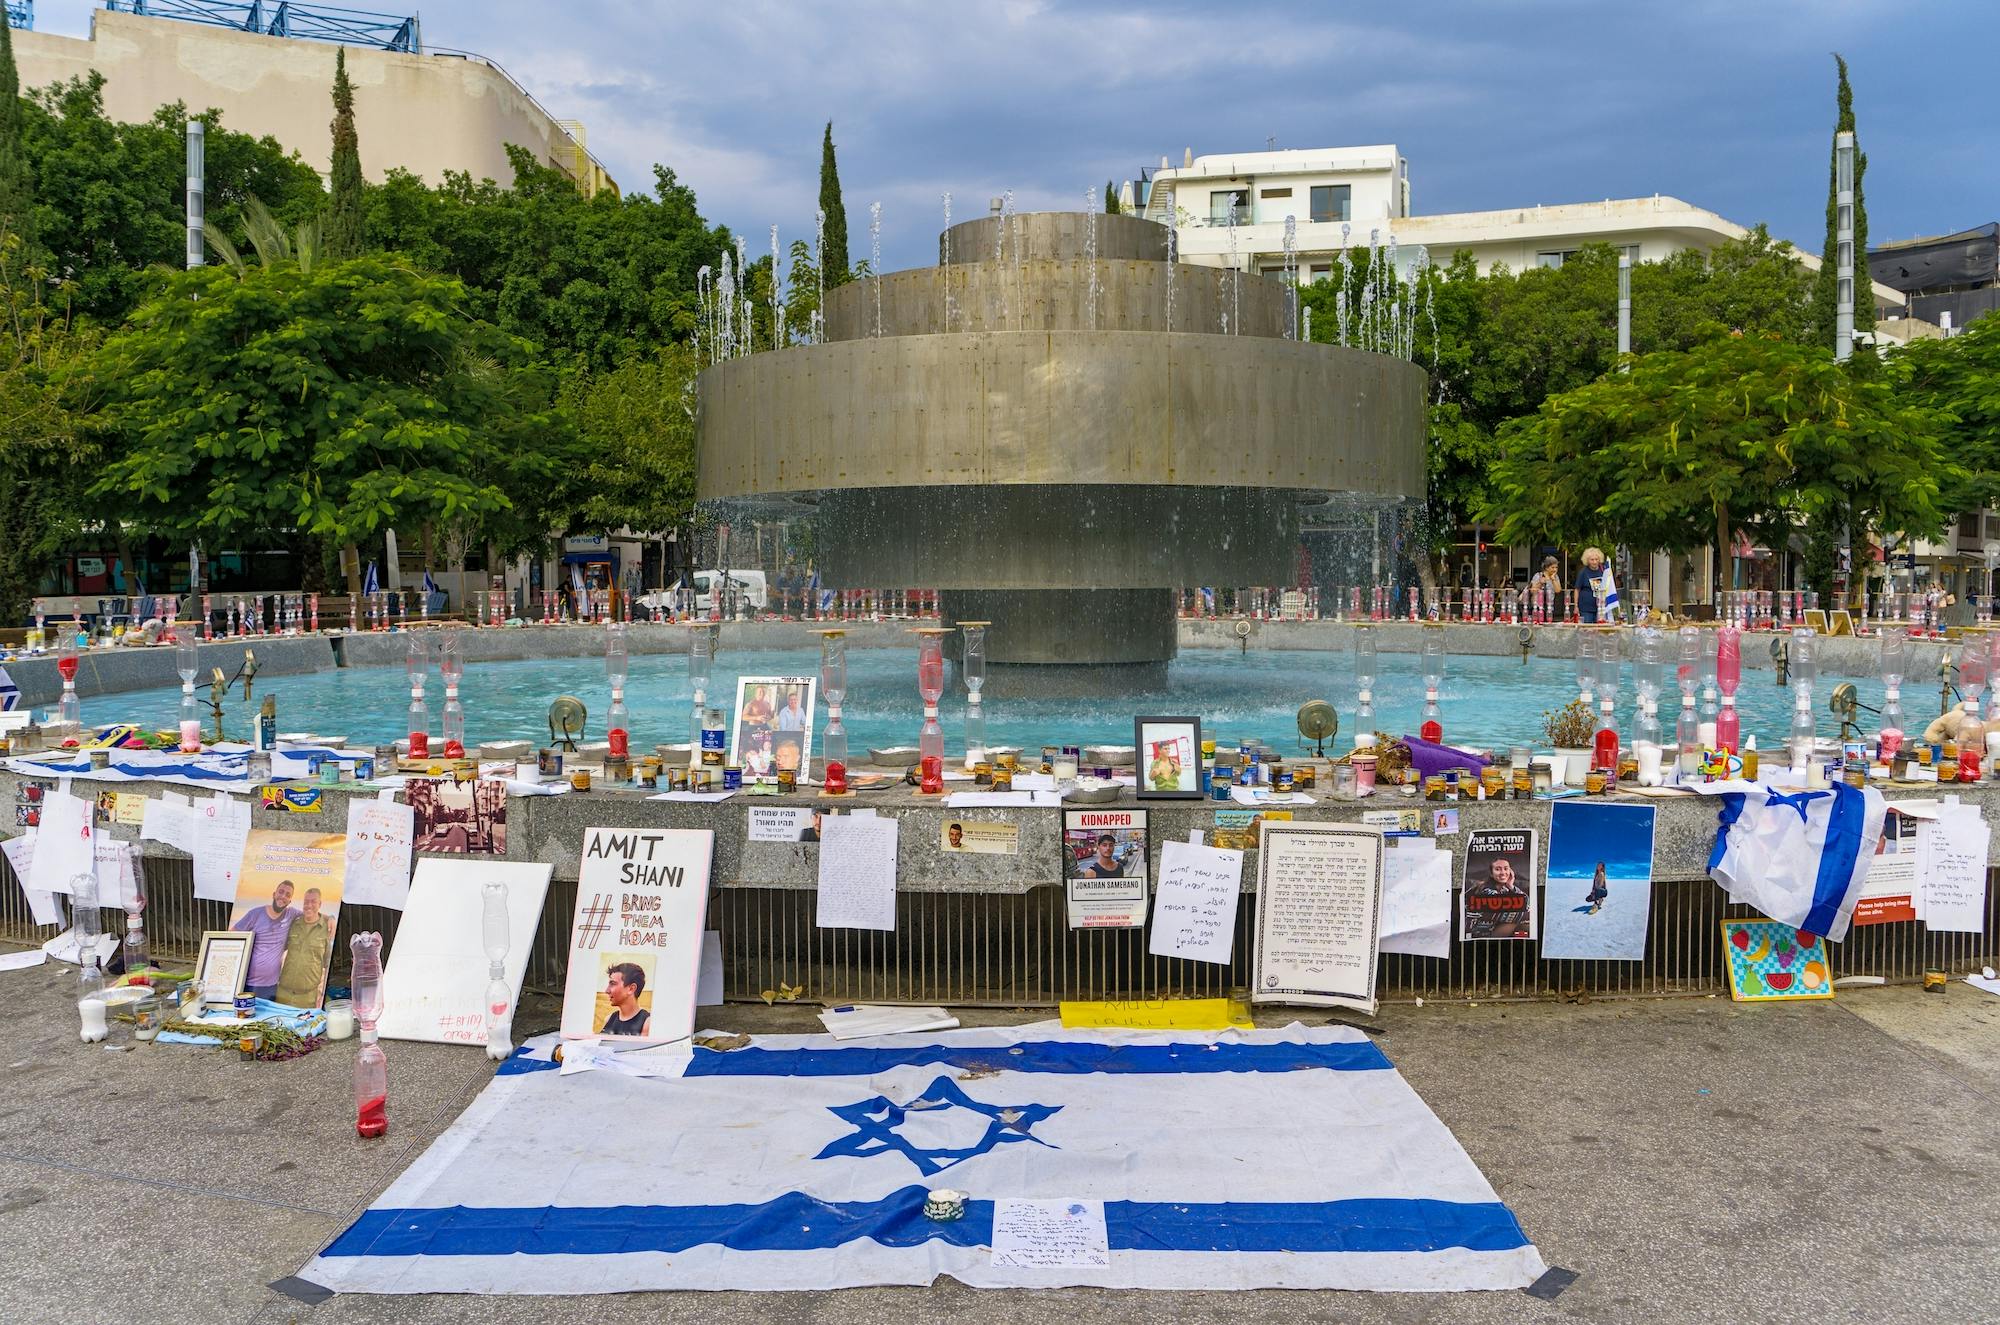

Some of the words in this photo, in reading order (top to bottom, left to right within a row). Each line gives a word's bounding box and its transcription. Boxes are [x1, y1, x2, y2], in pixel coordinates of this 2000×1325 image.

[1081, 814, 1131, 826] KIDNAPPED
[587, 832, 664, 860] AMIT
[1472, 836, 1485, 844] את
[1488, 836, 1524, 844] מחזירים
[1472, 844, 1501, 852] הביתה
[1503, 843, 1524, 851] נועה
[620, 863, 684, 888] SHANI
[1075, 881, 1106, 890] JONATHAN
[1107, 881, 1139, 889] SAMERANO
[621, 894, 661, 912] BRING
[1469, 896, 1524, 911] עכשיו!
[1874, 901, 1884, 909] help
[1884, 900, 1897, 908] bring
[621, 914, 664, 928] THEM
[619, 929, 668, 947] HOME
